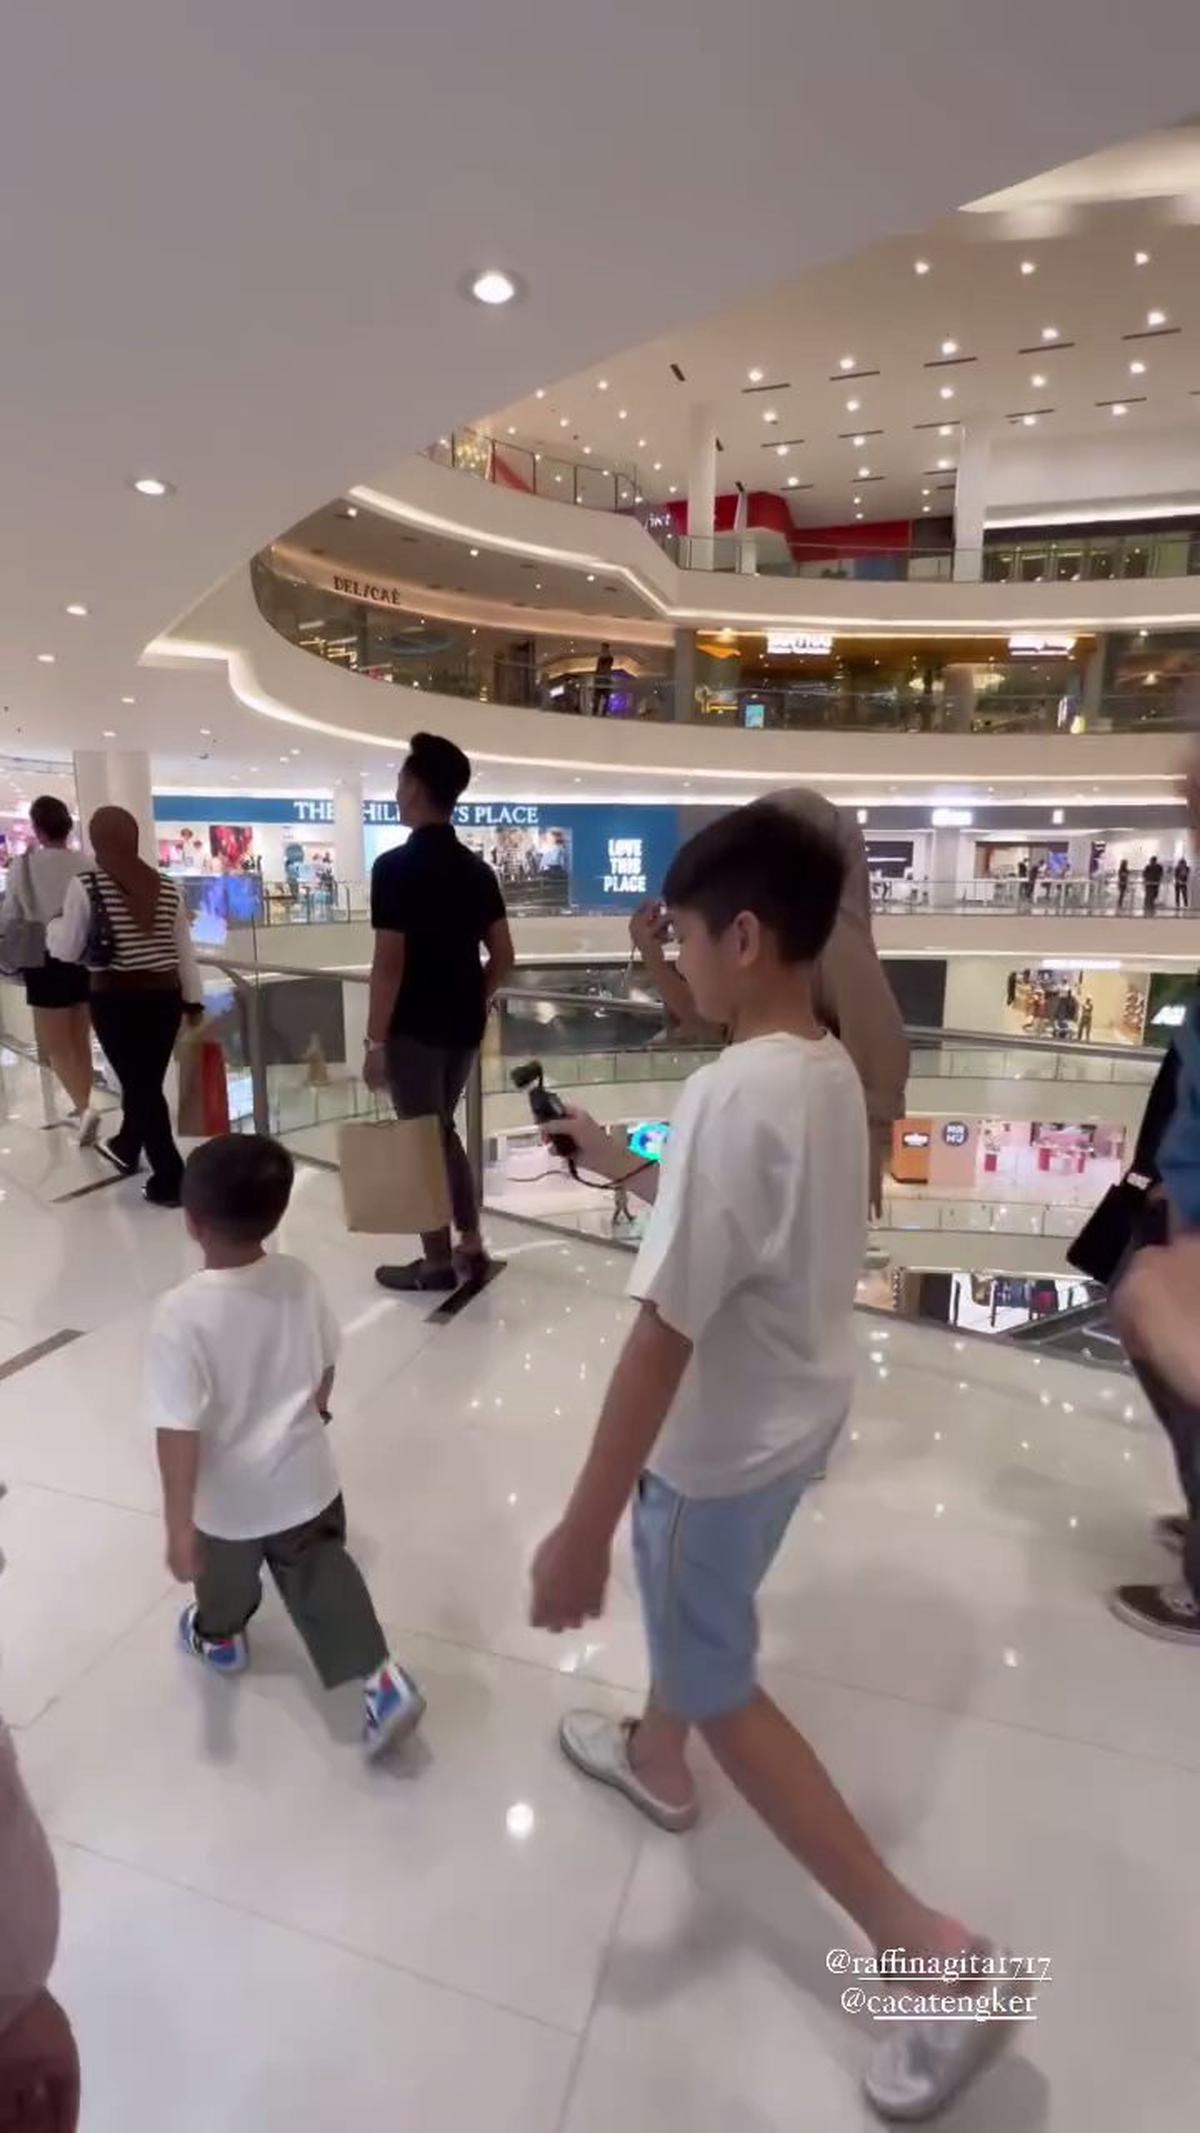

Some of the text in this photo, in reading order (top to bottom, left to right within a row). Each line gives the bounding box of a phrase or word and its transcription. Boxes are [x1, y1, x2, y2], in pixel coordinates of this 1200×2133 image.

[293, 801, 335, 821] THE
[474, 806, 539, 823] PLACE
[608, 838, 642, 857] LOVE
[609, 857, 642, 875] THIS
[603, 875, 647, 893] PLACE
